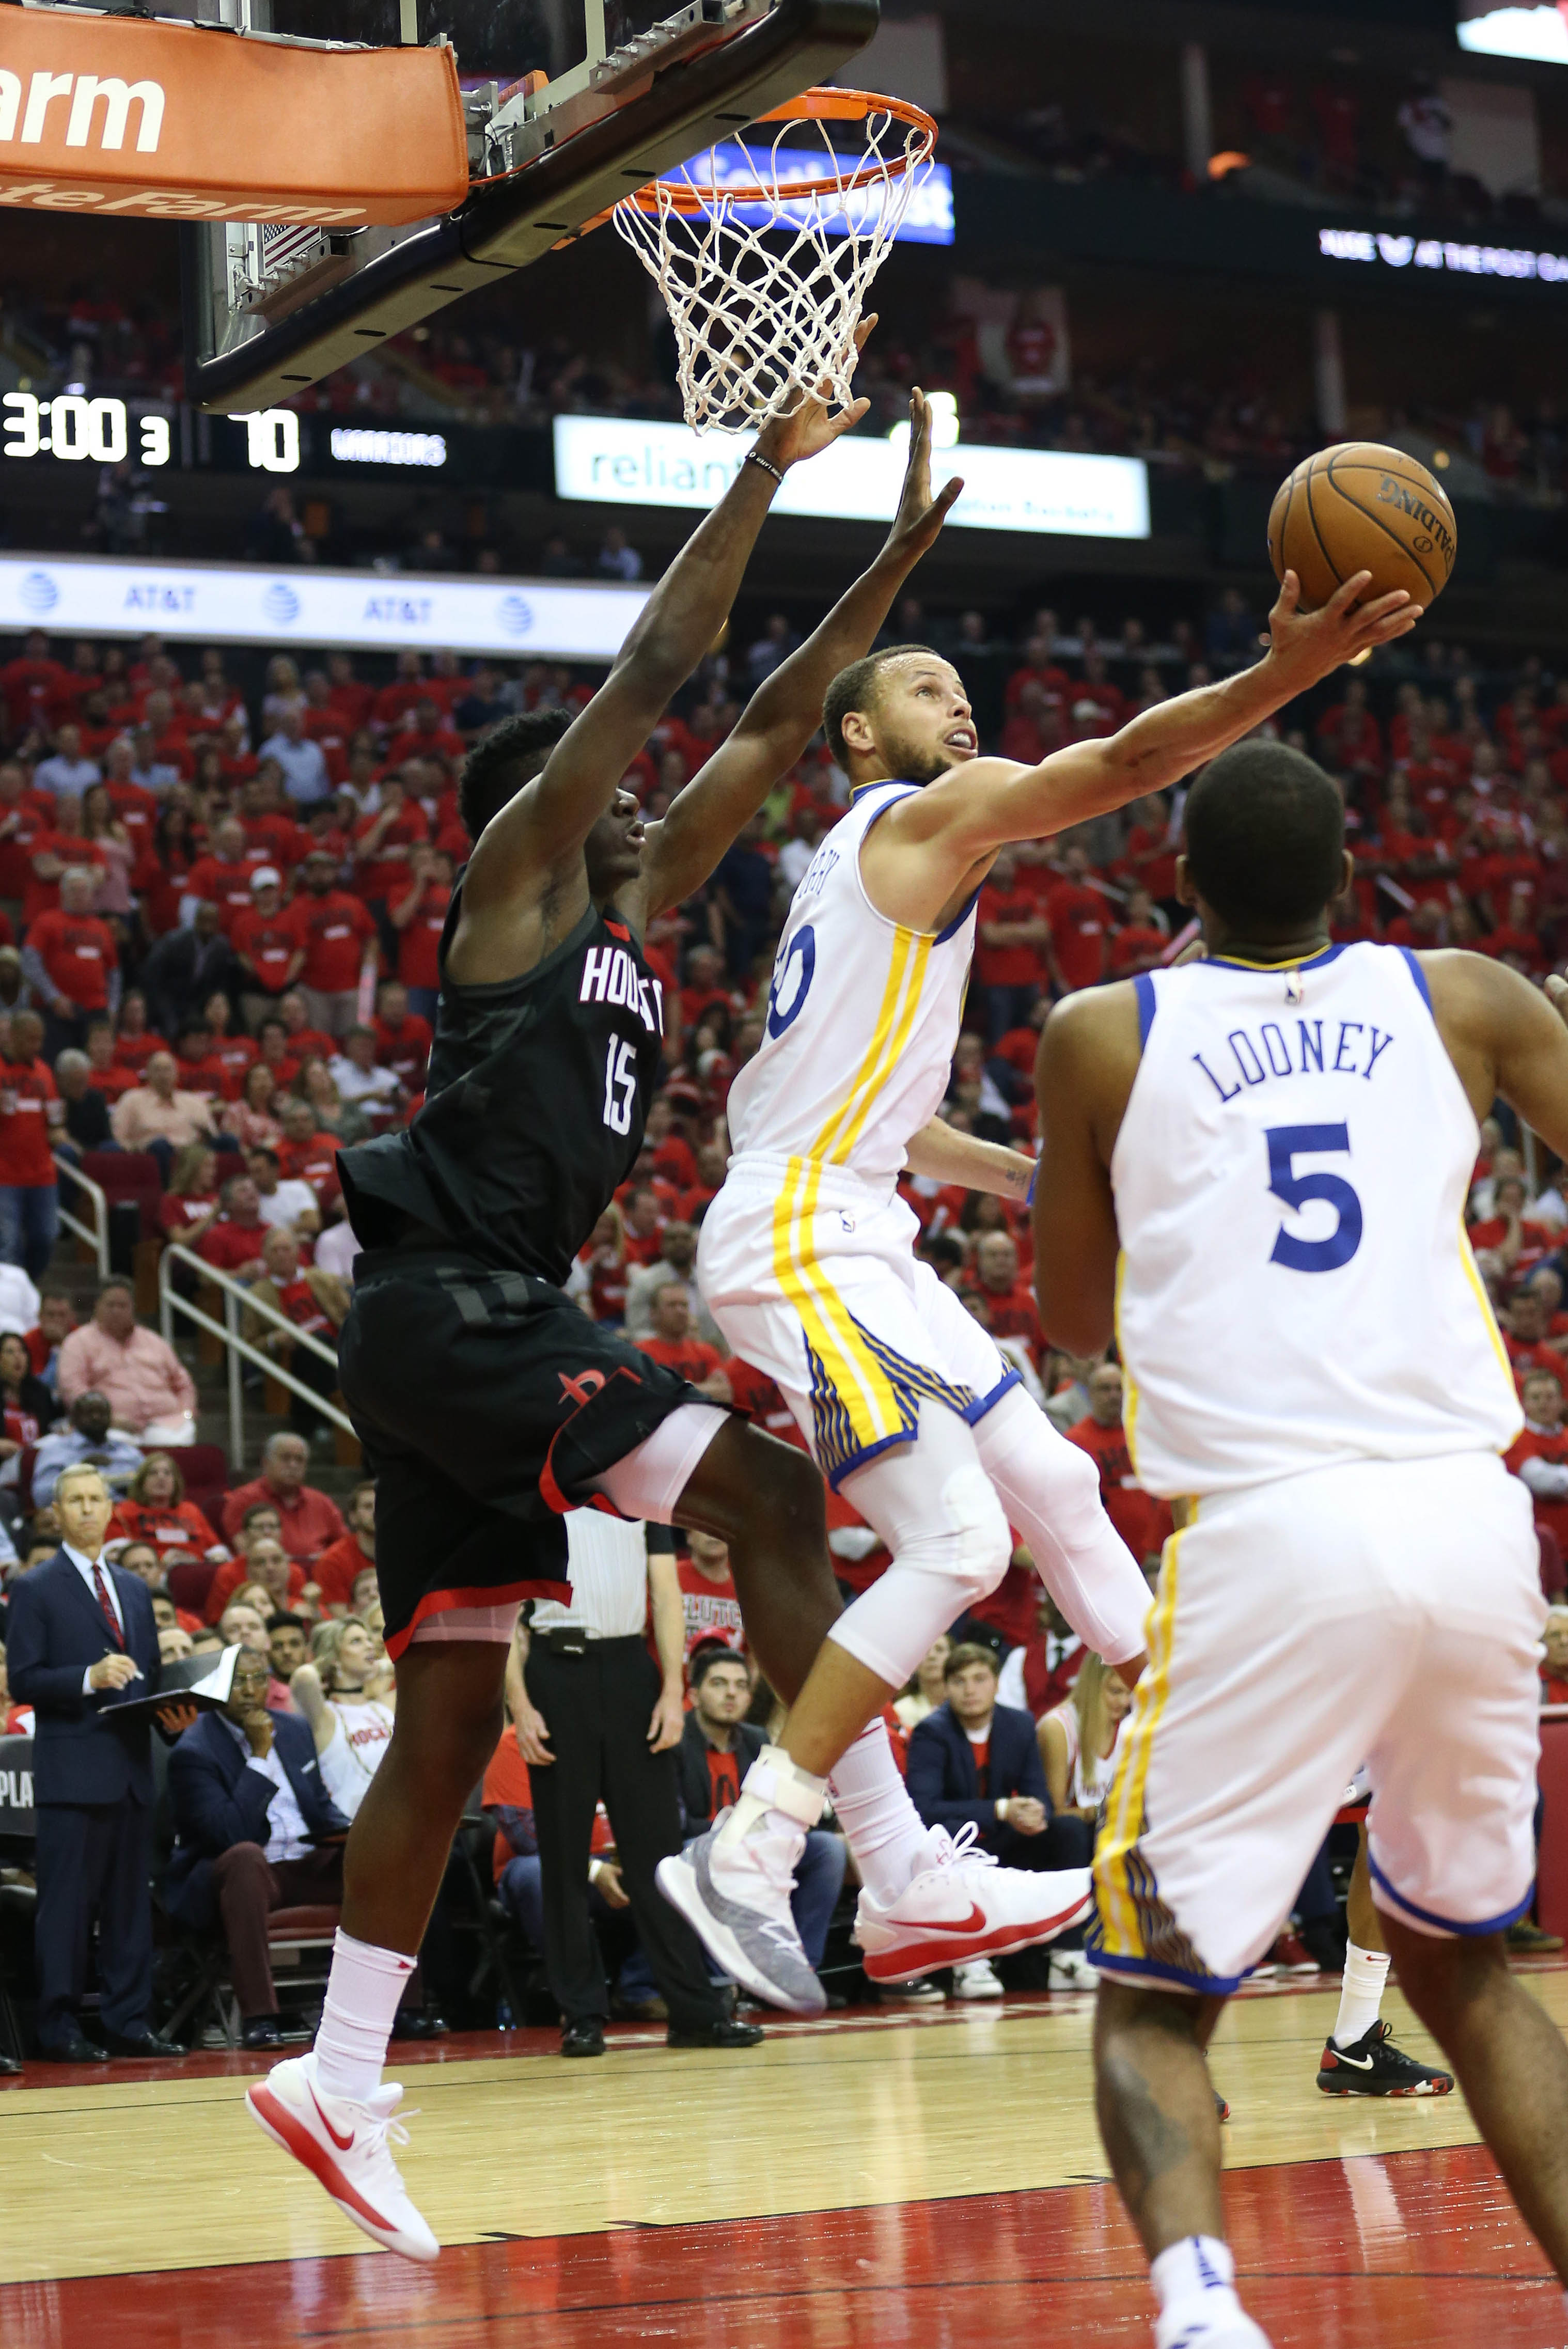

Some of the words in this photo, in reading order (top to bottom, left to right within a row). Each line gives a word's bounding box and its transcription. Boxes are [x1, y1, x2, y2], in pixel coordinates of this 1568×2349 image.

[93, 191, 367, 222] Farm
[2, 393, 128, 463] 3:00
[140, 415, 170, 465] 3
[227, 407, 300, 473] 70
[126, 584, 195, 612] AT&T
[366, 597, 435, 623] AT&T
[769, 925, 815, 1040] 0
[603, 1031, 637, 1136] 15
[1192, 1020, 1393, 1102] LOONEY
[1263, 1119, 1363, 1273] 5
